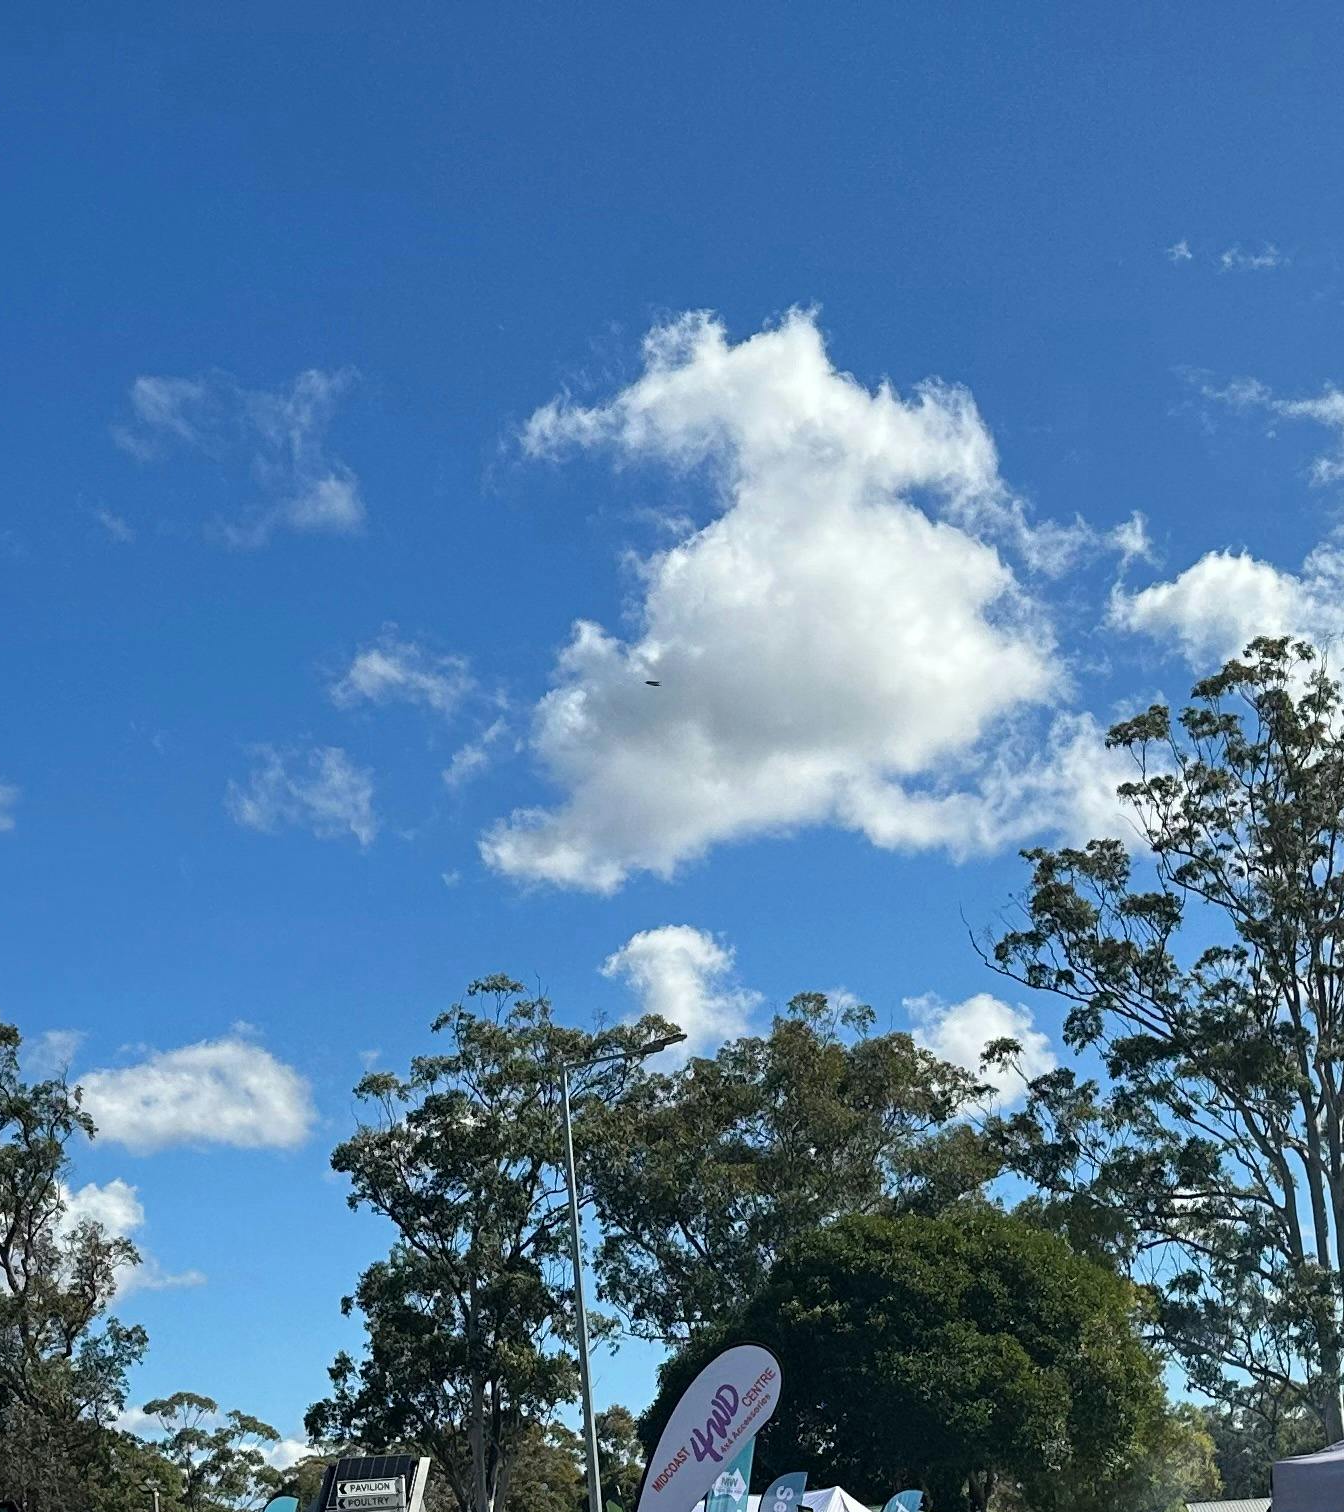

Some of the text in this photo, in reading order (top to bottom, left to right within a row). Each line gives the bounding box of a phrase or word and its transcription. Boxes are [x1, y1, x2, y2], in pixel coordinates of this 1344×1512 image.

[652, 1367, 776, 1494] MIDCOAST 4WD CENTRE
[350, 1483, 390, 1492] PAVILION
[348, 1497, 389, 1506] POULTRY
